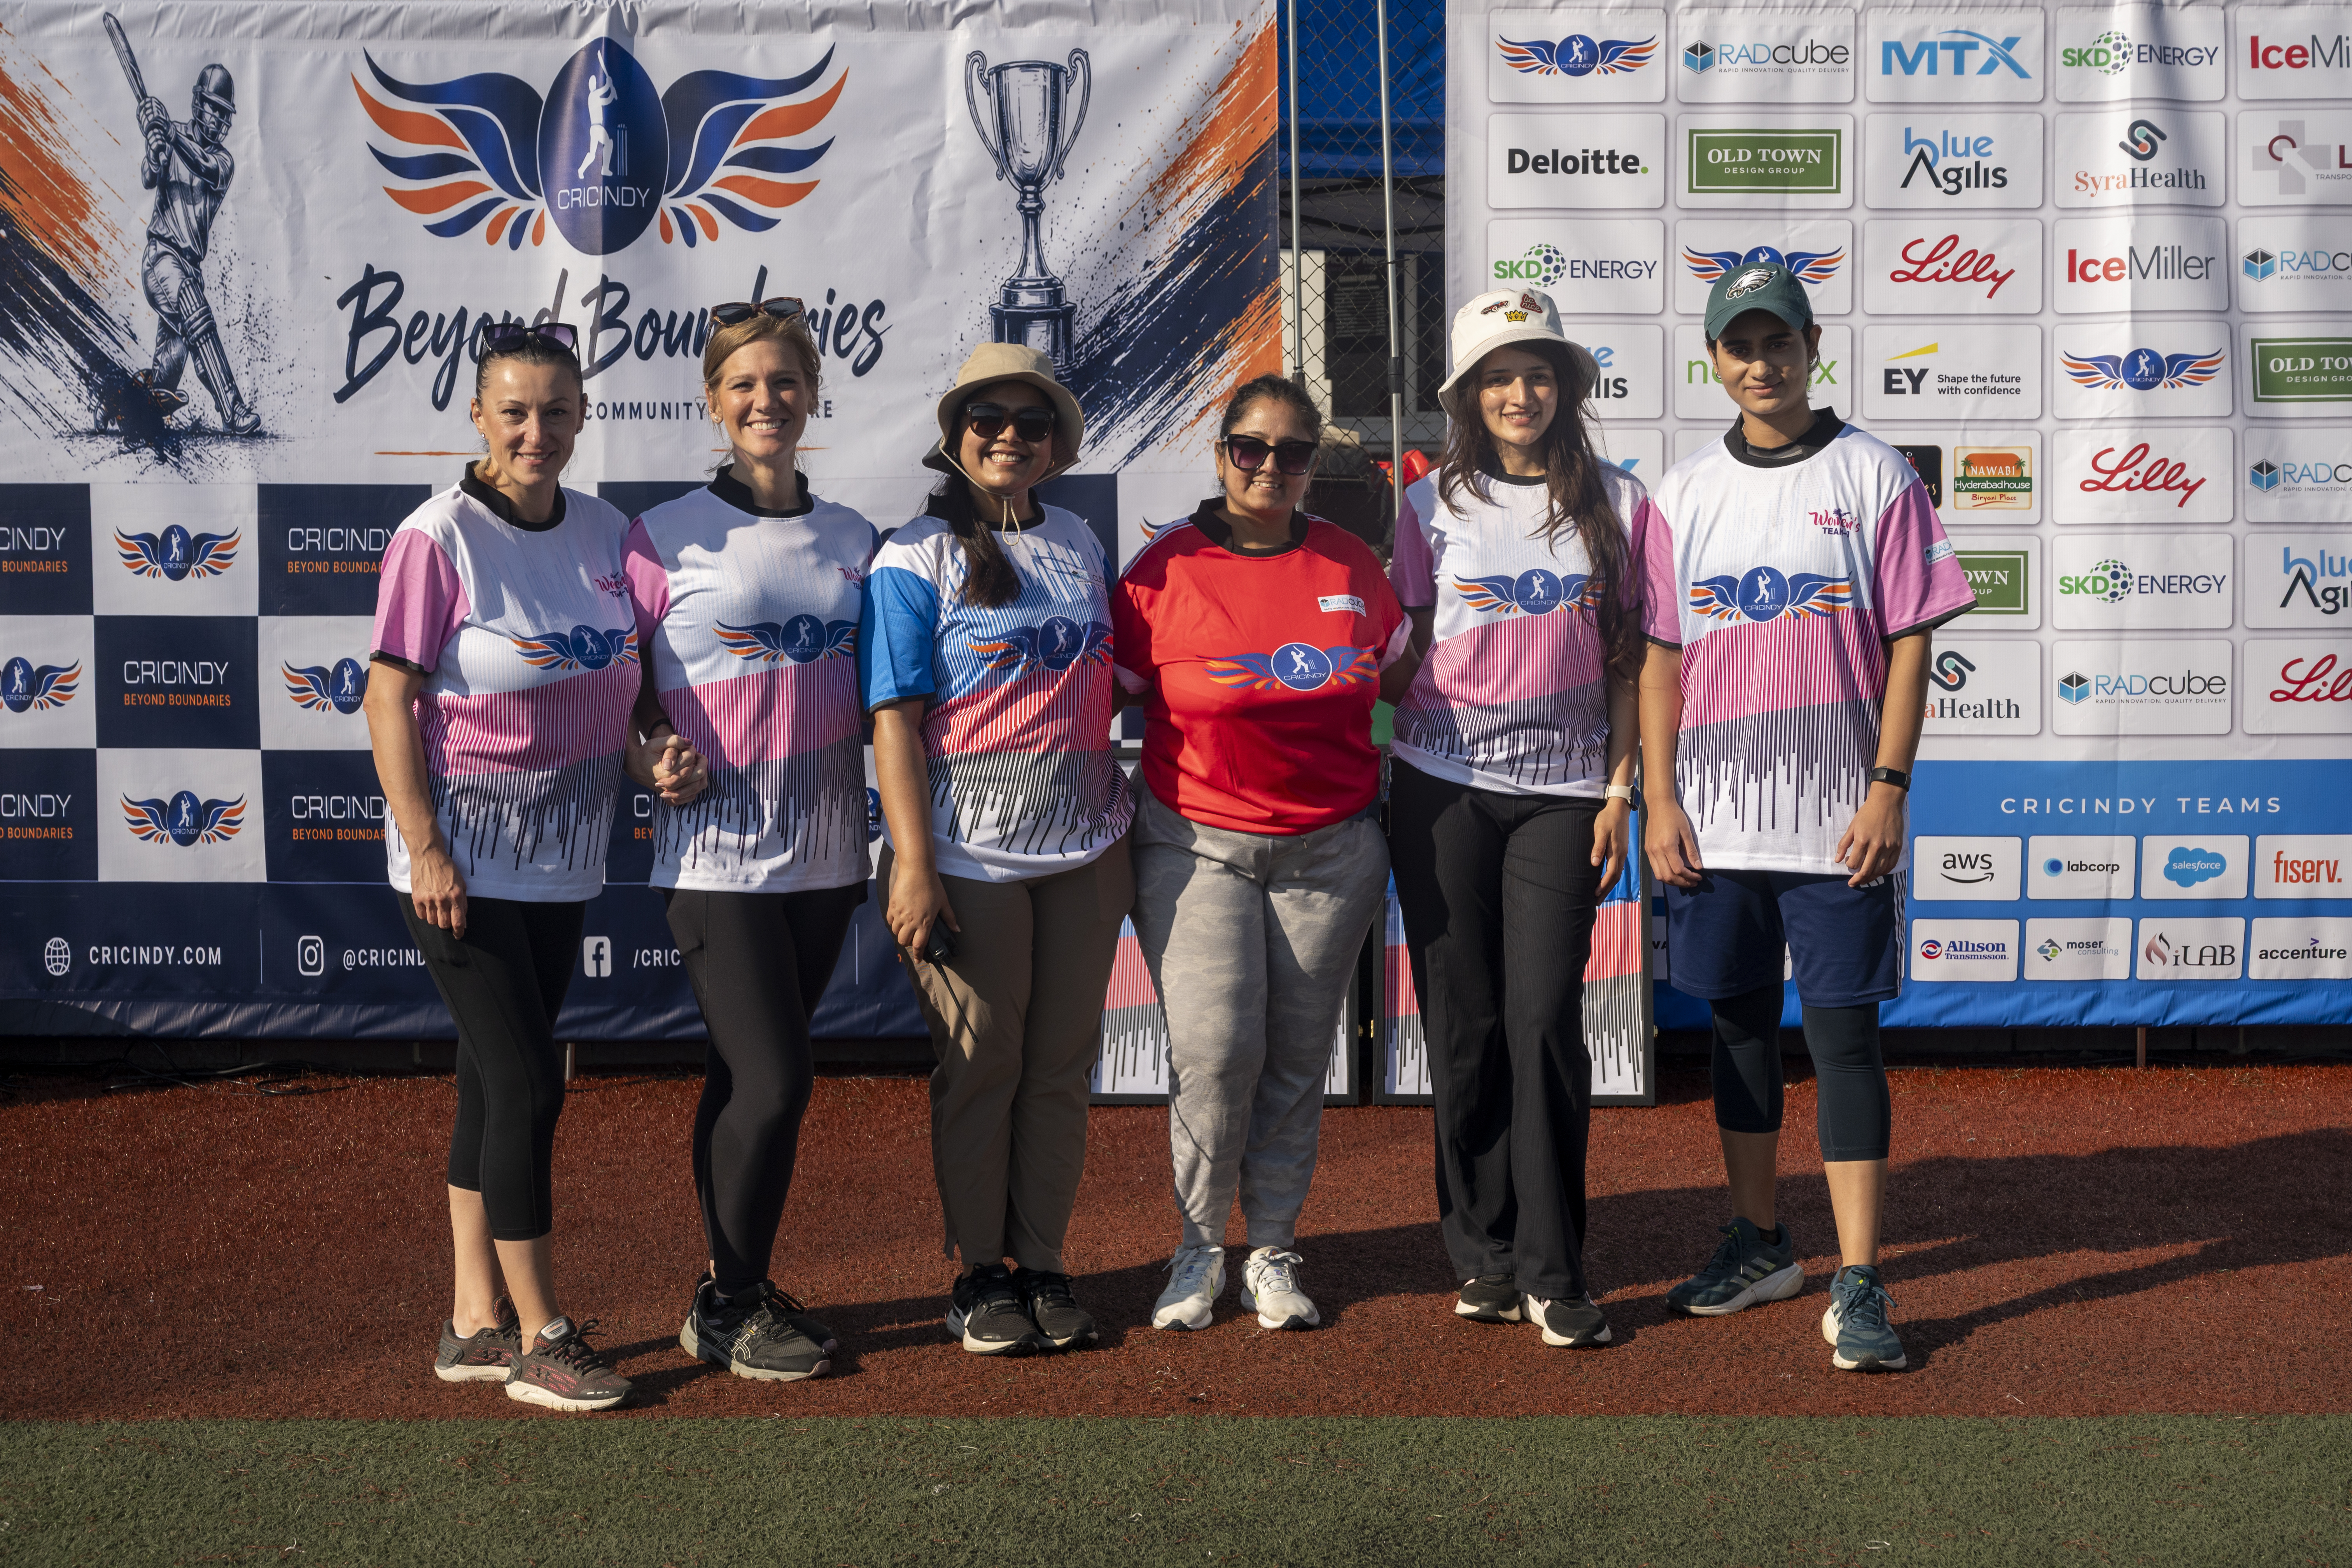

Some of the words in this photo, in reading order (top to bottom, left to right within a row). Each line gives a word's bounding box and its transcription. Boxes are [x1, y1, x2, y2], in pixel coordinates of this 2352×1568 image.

[1719, 39, 1850, 65] RADcube
[1882, 34, 2032, 79] MTX
[2062, 48, 2111, 67] SKD
[2137, 44, 2219, 67] ENERGY
[2250, 35, 2350, 69] IceMi
[1708, 149, 1753, 164] OLD
[1757, 149, 1822, 164] TOWN
[1904, 127, 1995, 168] blue
[1508, 148, 1649, 174] Deloitte.
[1900, 146, 2008, 195] Agilis
[2074, 167, 2207, 197] SyraHealth
[557, 186, 650, 210] CRICINDY
[1494, 260, 1542, 280] SKD
[1570, 260, 1657, 280] ENERGY
[1890, 234, 2015, 299] Lilly
[2067, 245, 2215, 283] IceMiller
[2280, 251, 2350, 271] RADc
[1521, 302, 1541, 311] nice
[1524, 295, 1535, 304] be
[2270, 357, 2318, 373] OLD
[2322, 355, 2352, 371] TO
[1884, 368, 1929, 394] EY
[1937, 374, 1968, 385] Shape
[1970, 374, 1987, 383] the
[1990, 374, 2021, 383] future
[1937, 386, 1961, 395] with
[1964, 386, 2021, 395] confidence
[584, 401, 707, 420] COMMUNITY
[1970, 466, 2015, 476] NAWABI
[2080, 443, 2207, 508] Lilly
[2283, 463, 2352, 483] RADc
[1971, 494, 1997, 503] Biryani
[0, 527, 65, 551] CINDY
[2, 560, 68, 572] BOUNDARIES
[287, 561, 329, 573] BEYOND
[333, 561, 382, 573] BOUNDAR
[2283, 546, 2352, 587] blu
[1963, 570, 2009, 586] OWN
[2059, 575, 2109, 594] SKD
[2138, 575, 2226, 594] ENERGY
[2280, 566, 2352, 615] Agi
[579, 653, 610, 661] CRICINDY
[124, 661, 229, 685] CRICINDY
[1284, 672, 1326, 681] CRICINDY
[2096, 670, 2227, 695] RADcube
[2270, 654, 2352, 702] Lil
[124, 694, 166, 705] BEYOND
[169, 694, 231, 706] BOUNDARIES
[1924, 697, 2021, 719] aHealth
[1, 794, 71, 817] CINDY
[292, 796, 385, 819] CRICIND
[2000, 798, 2157, 814] CRICINDY
[2177, 797, 2281, 813] TEAMS
[8, 827, 73, 839] BOUNDARIES
[293, 829, 333, 840] BEYOND
[337, 829, 386, 840] BOUNDAR
[634, 828, 653, 839] BEY
[1943, 853, 1993, 870] aws
[2067, 860, 2120, 874] labcorp
[2173, 860, 2221, 872] salesforce
[2274, 850, 2342, 883] fiserv.
[1945, 940, 2006, 953] Allison
[2067, 940, 2104, 950] moser
[2077, 945, 2119, 956] consulting
[2259, 945, 2347, 960] accenture
[89, 946, 221, 965] CRICINDY.COM
[343, 949, 426, 970] @CRICIND
[634, 948, 681, 968] /CRIC
[2173, 945, 2236, 966] iLAB
